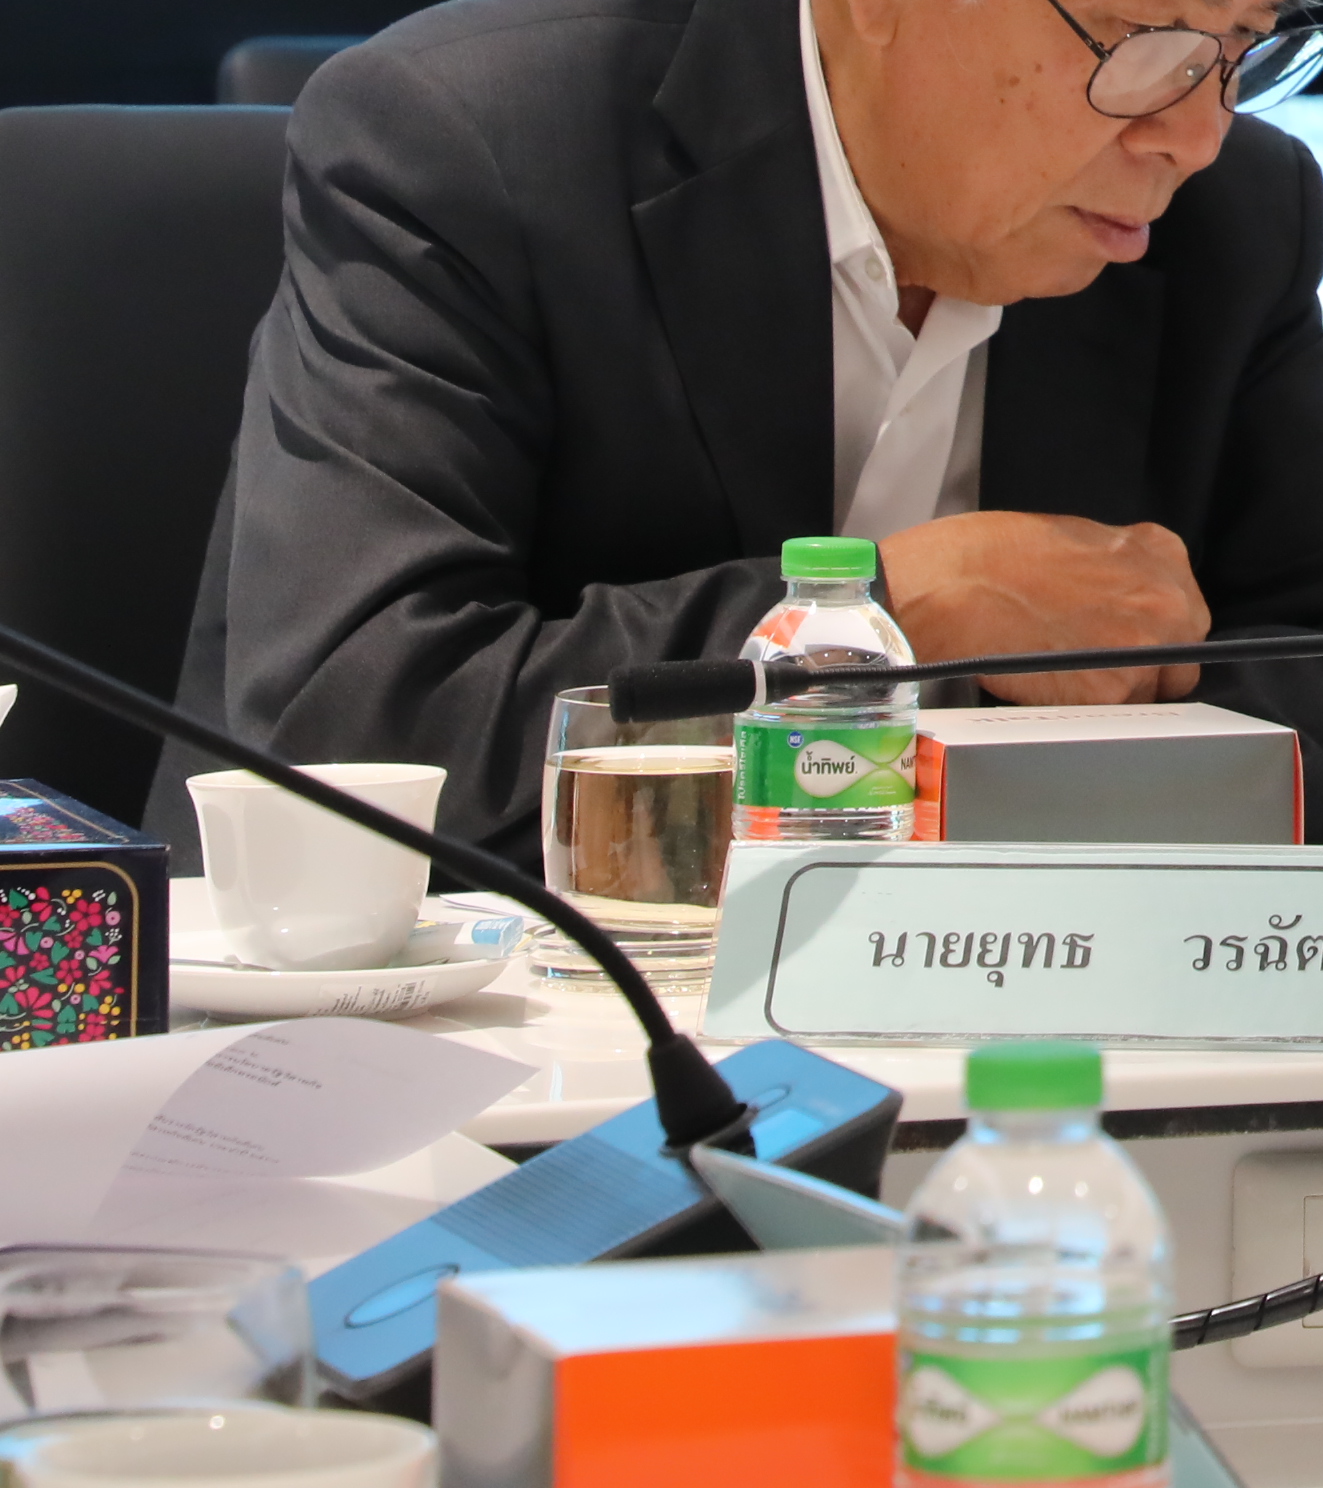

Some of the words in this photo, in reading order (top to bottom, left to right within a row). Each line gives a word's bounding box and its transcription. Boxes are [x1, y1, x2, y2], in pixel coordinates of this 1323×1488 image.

[801, 751, 856, 775] น้ำทิพย์
[867, 930, 1096, 989] นายยุทธ
